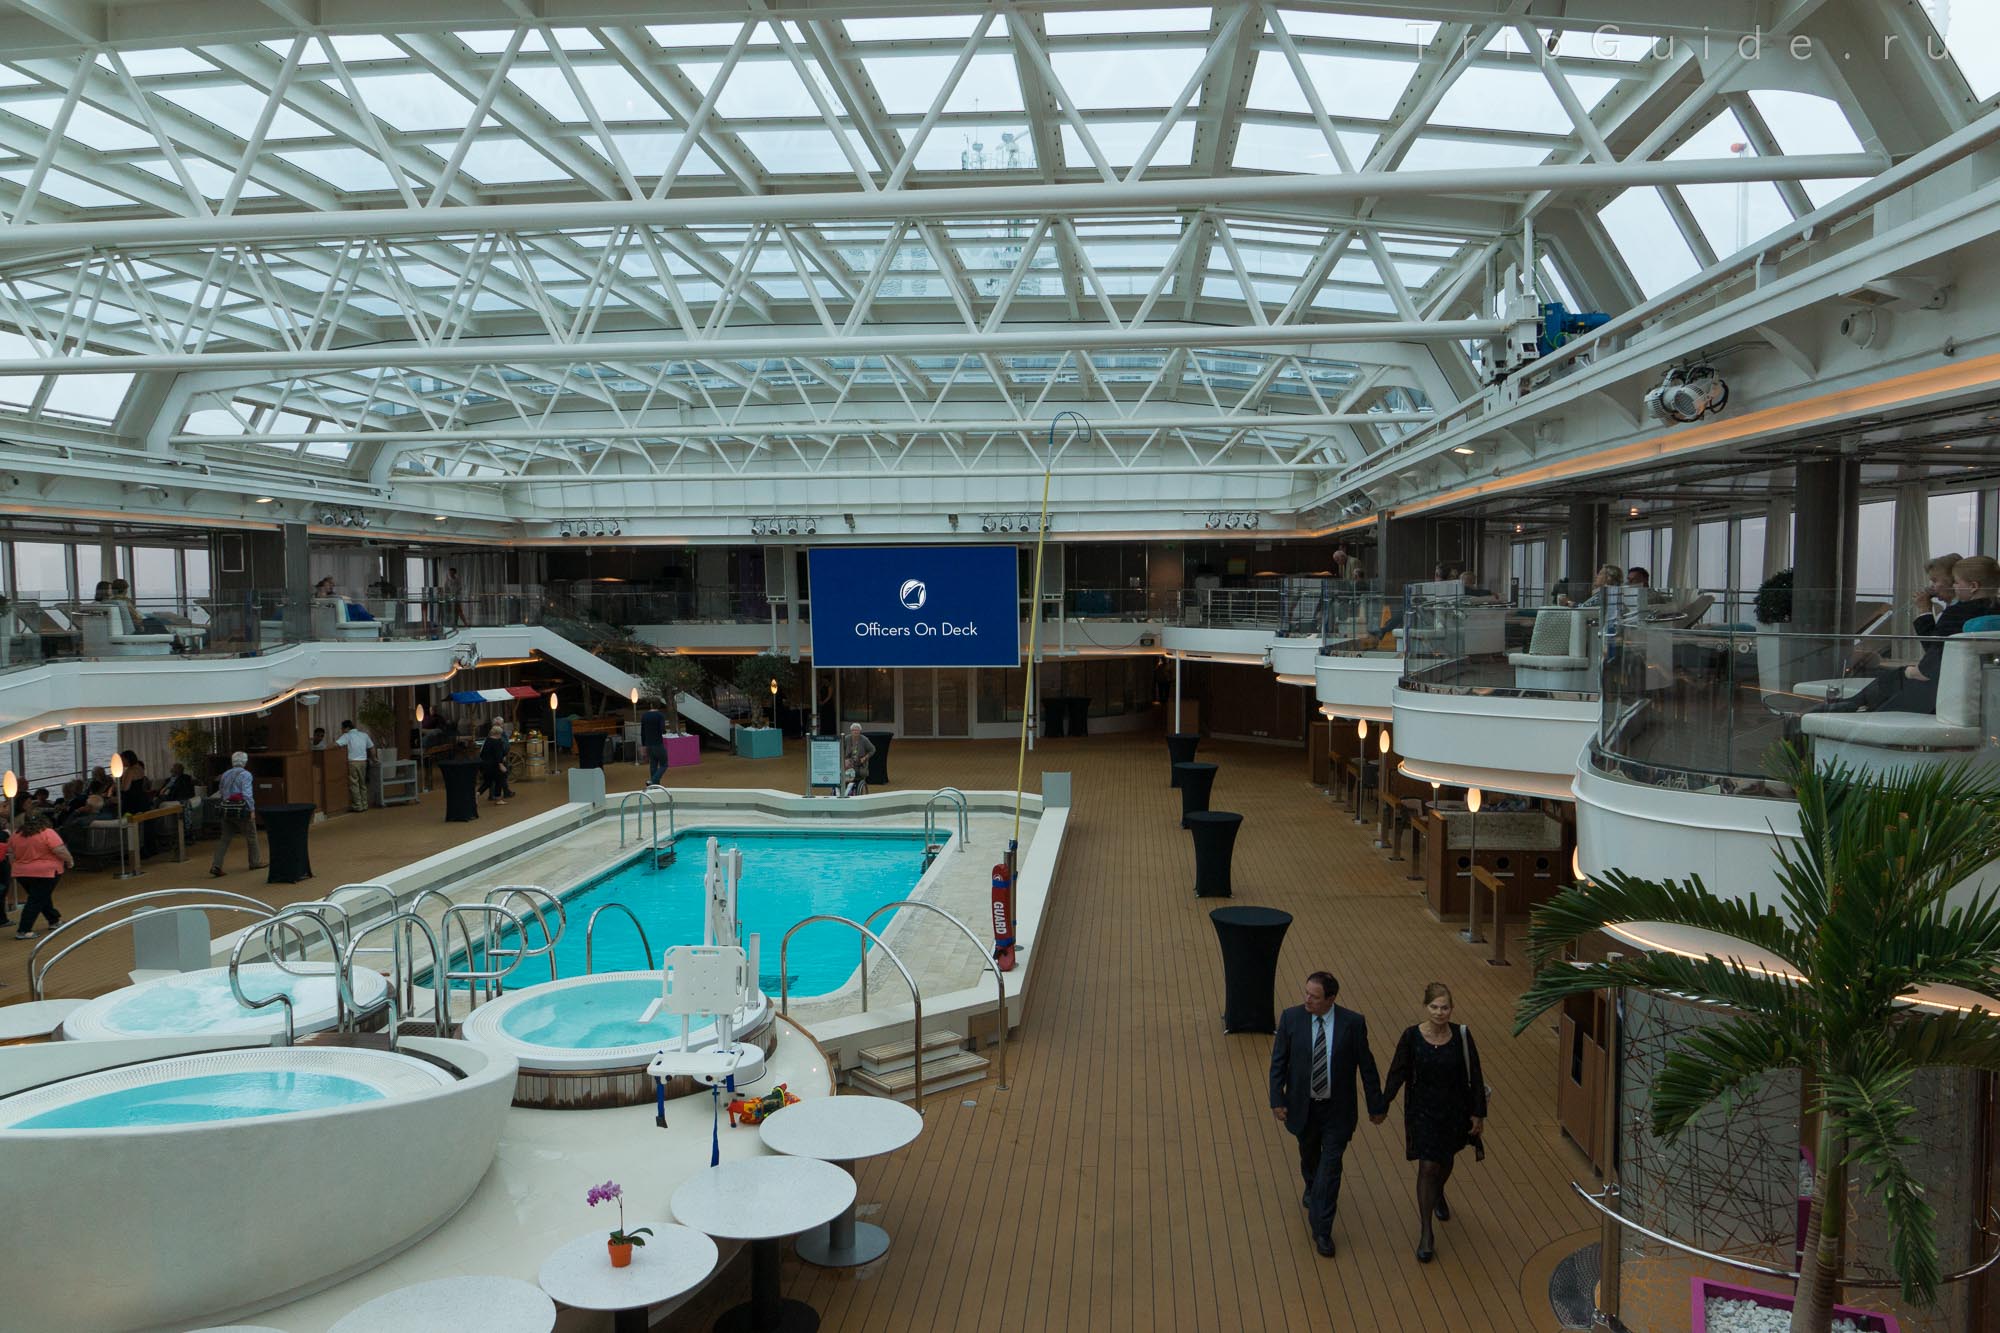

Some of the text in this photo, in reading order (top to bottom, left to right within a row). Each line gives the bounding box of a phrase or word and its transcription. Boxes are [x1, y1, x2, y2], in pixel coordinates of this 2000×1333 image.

[855, 621, 978, 637] Officers On Deck
[993, 901, 1007, 935] GUARD
